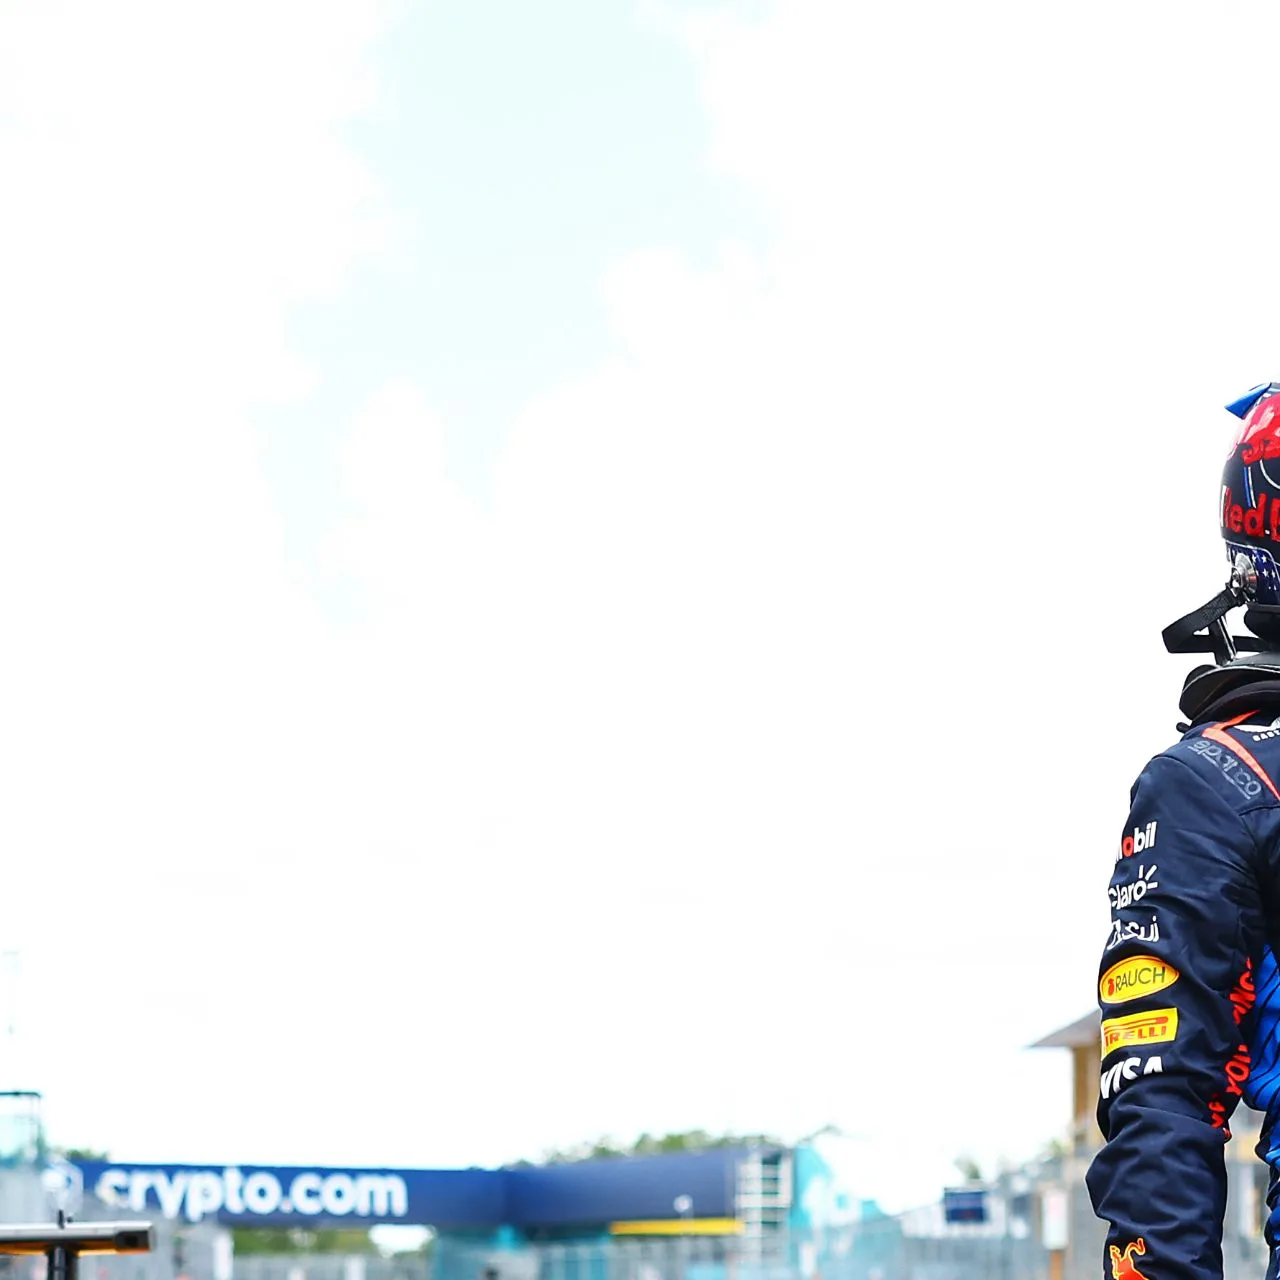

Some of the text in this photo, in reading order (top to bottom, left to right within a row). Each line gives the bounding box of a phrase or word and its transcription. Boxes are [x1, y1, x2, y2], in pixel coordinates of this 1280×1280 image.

[1188, 740, 1262, 800] sparco
[1114, 966, 1166, 993] RAUCH
[95, 1166, 409, 1223] crypto.com
